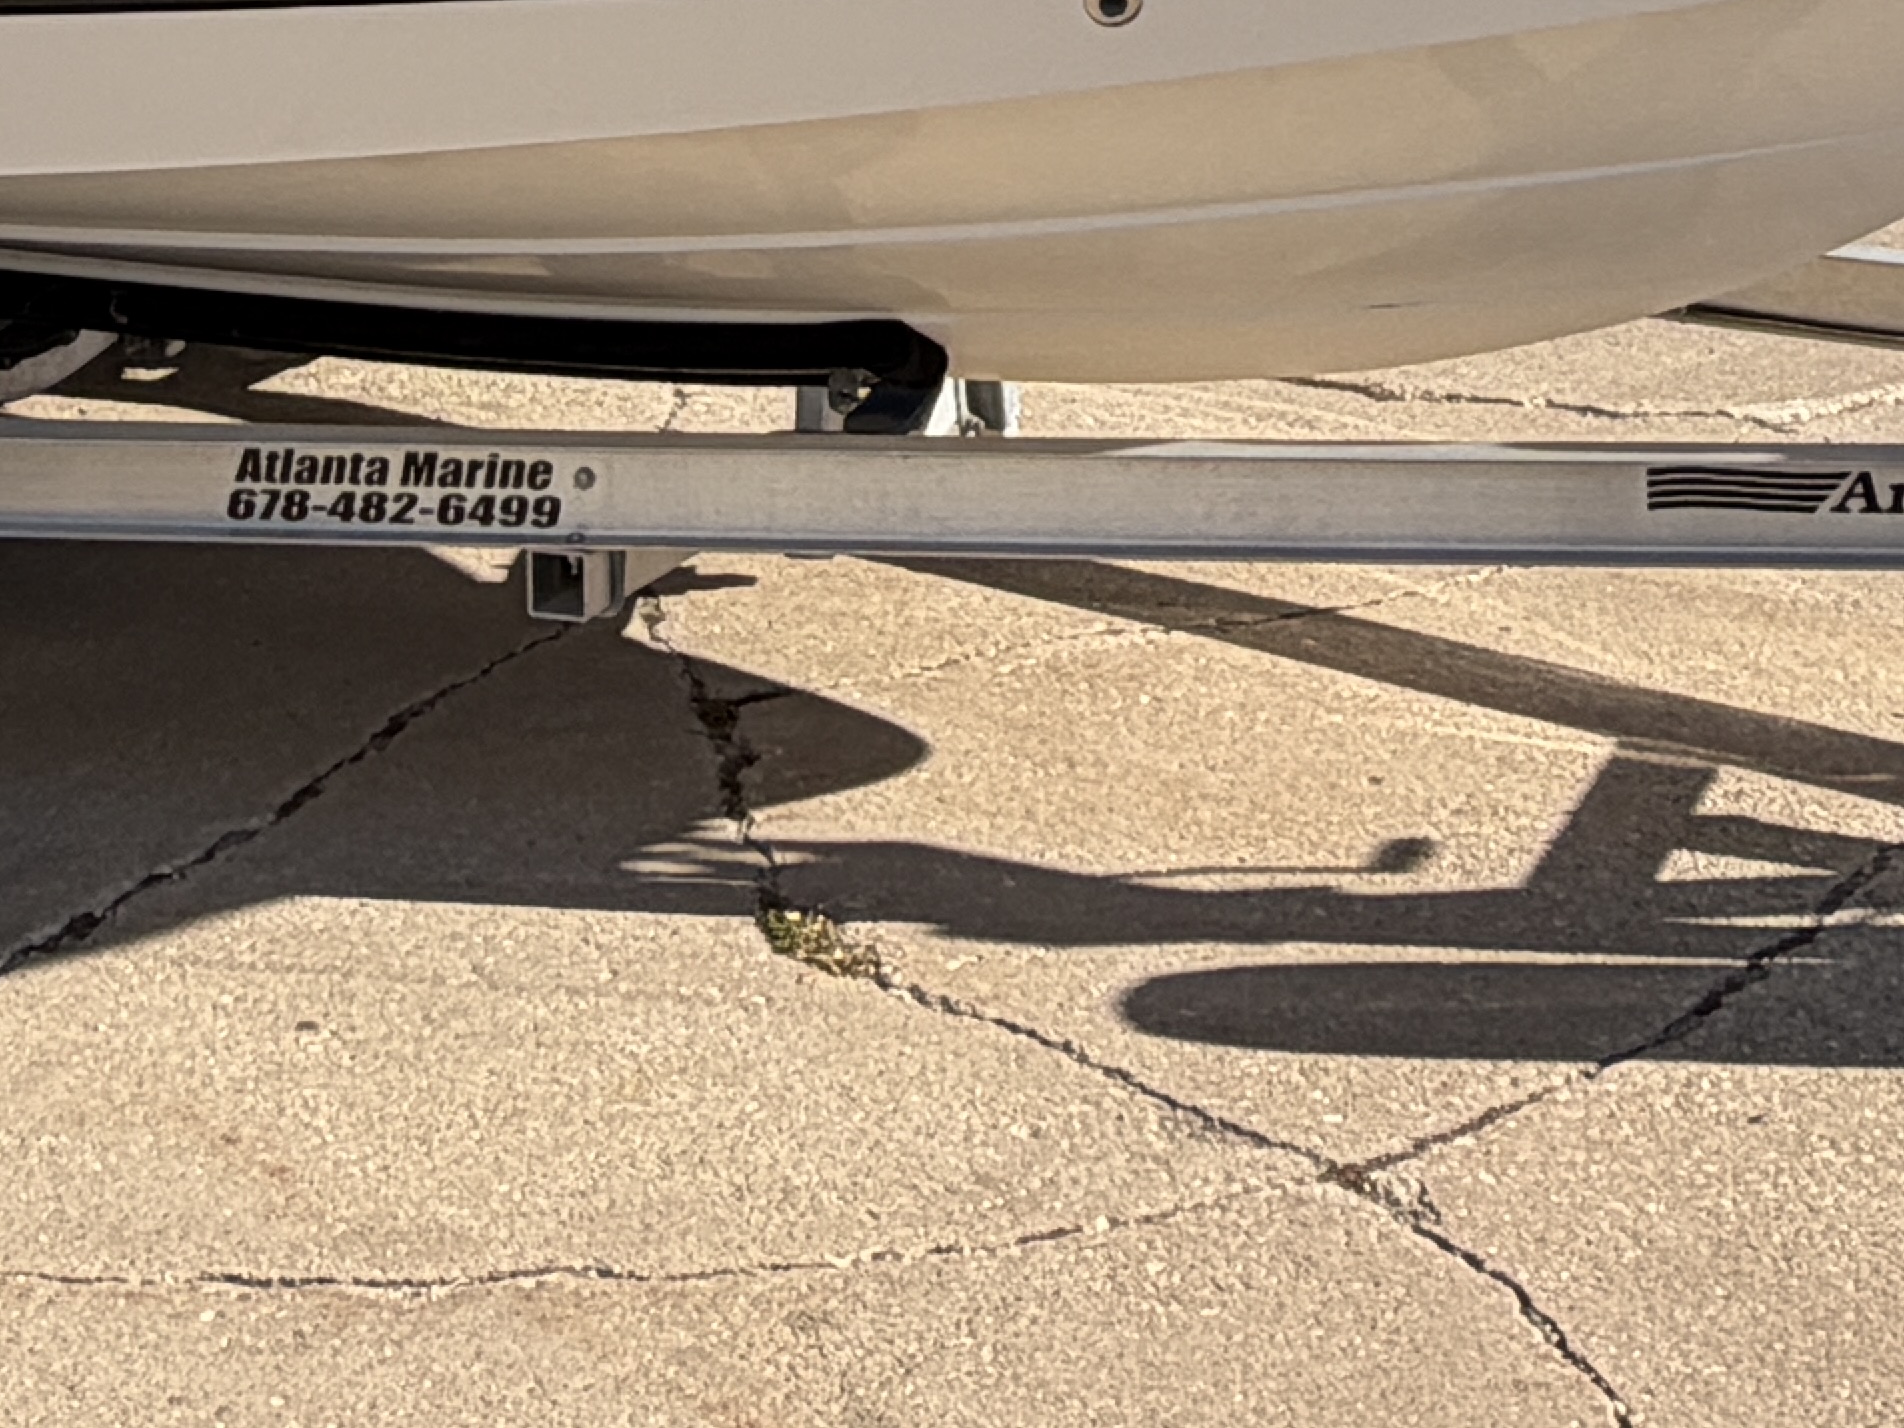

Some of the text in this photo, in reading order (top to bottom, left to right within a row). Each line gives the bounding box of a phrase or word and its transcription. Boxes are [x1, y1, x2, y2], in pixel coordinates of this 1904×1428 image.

[234, 447, 555, 491] Atlanta Marine
[226, 488, 563, 528] 678-482-6499
